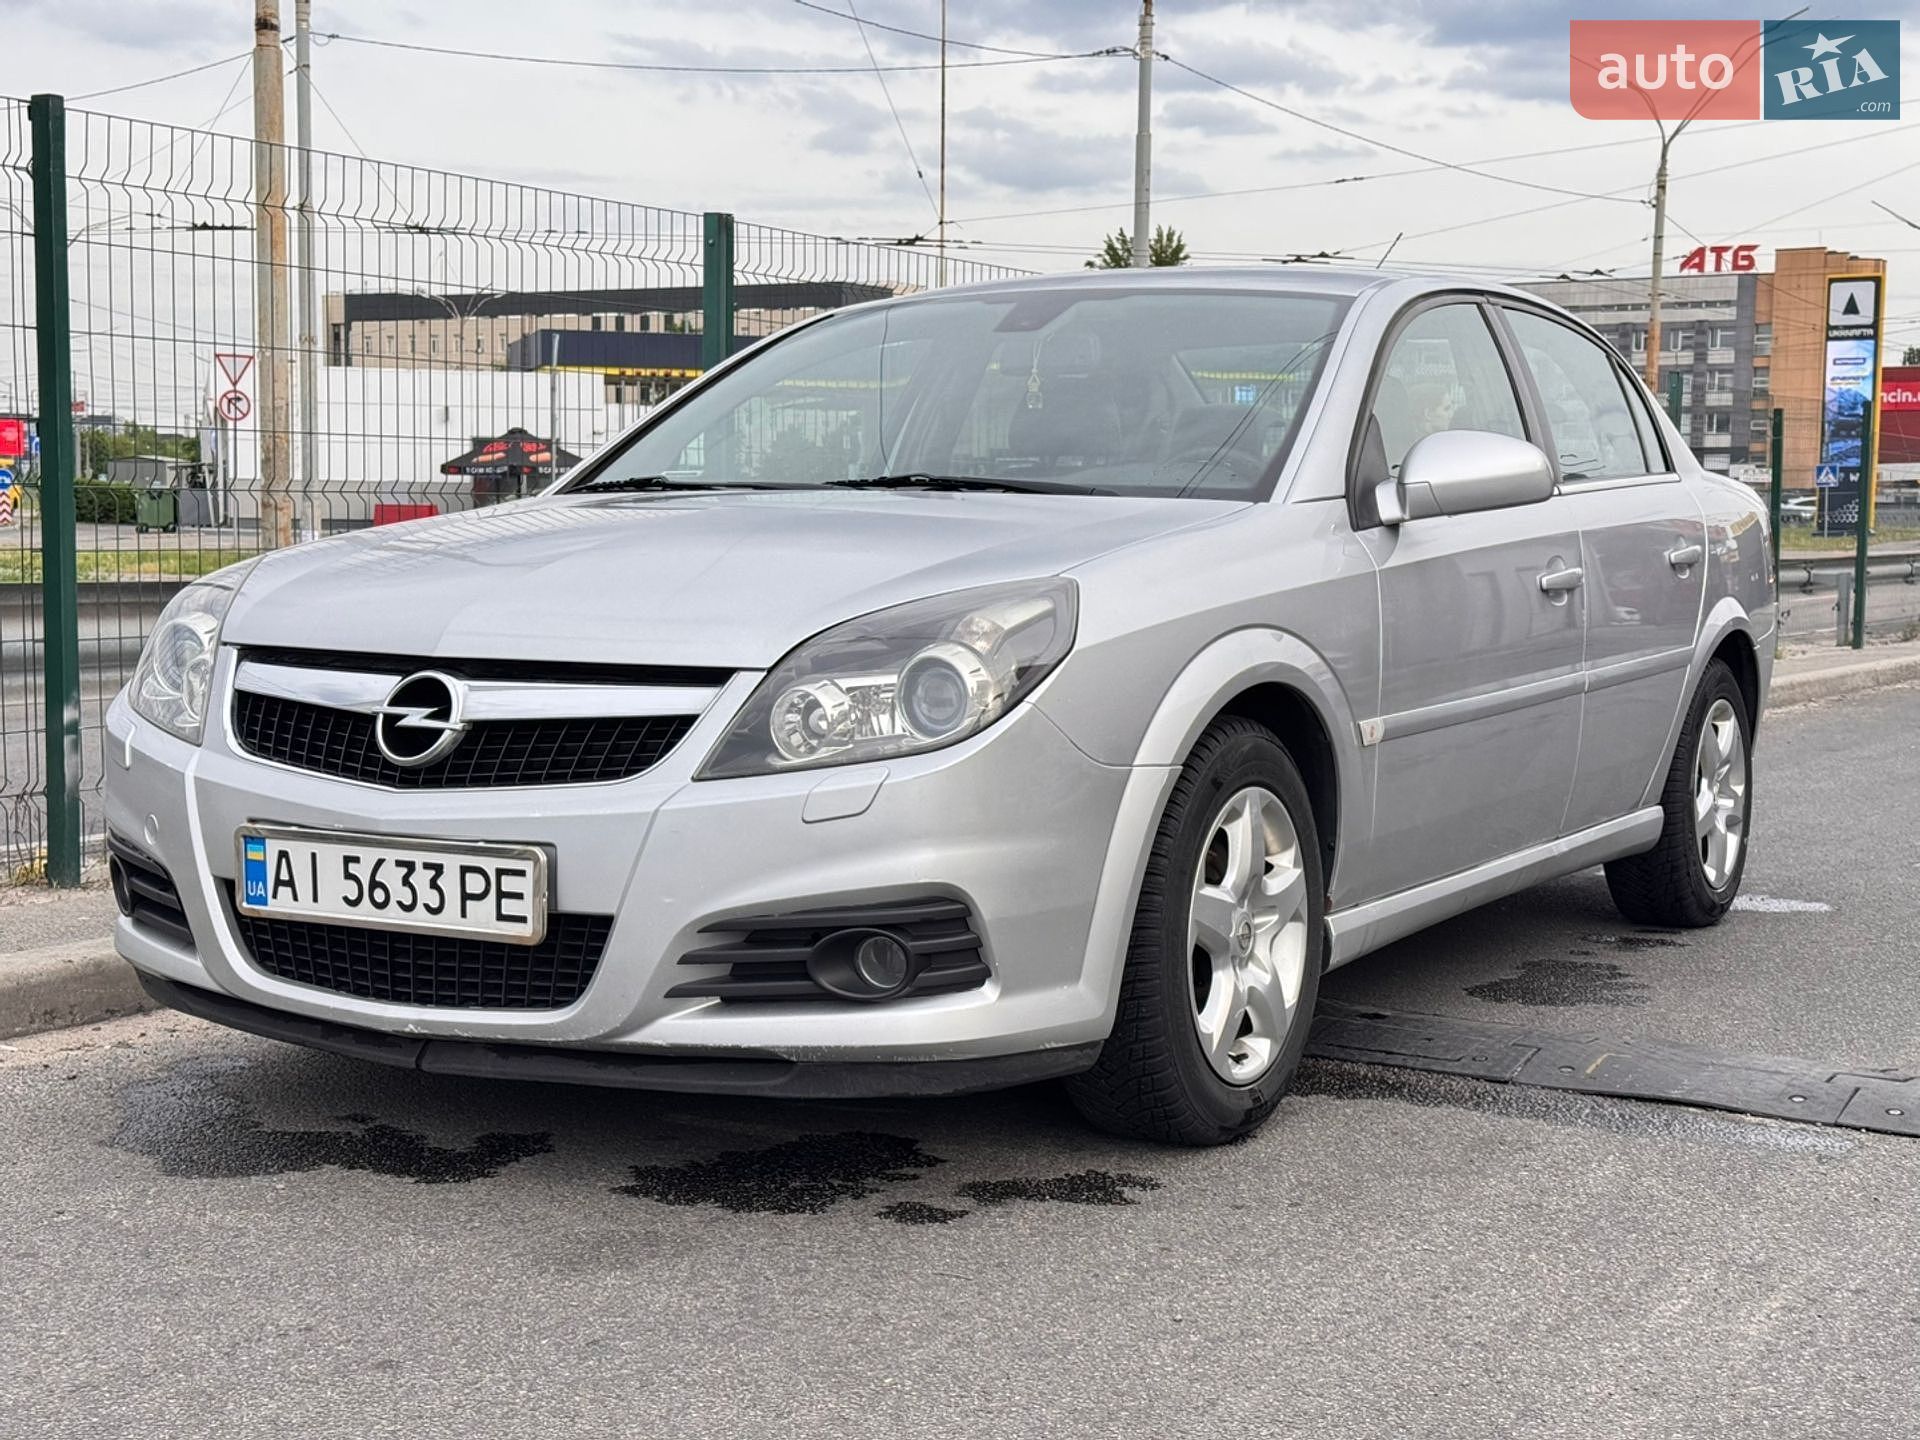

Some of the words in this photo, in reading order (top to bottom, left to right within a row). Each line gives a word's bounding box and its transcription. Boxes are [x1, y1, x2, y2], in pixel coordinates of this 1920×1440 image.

[1679, 245, 1760, 273] АТБ
[248, 880, 266, 898] UA
[271, 849, 319, 904] AI
[341, 854, 446, 916] 5633
[459, 864, 528, 924] PE
